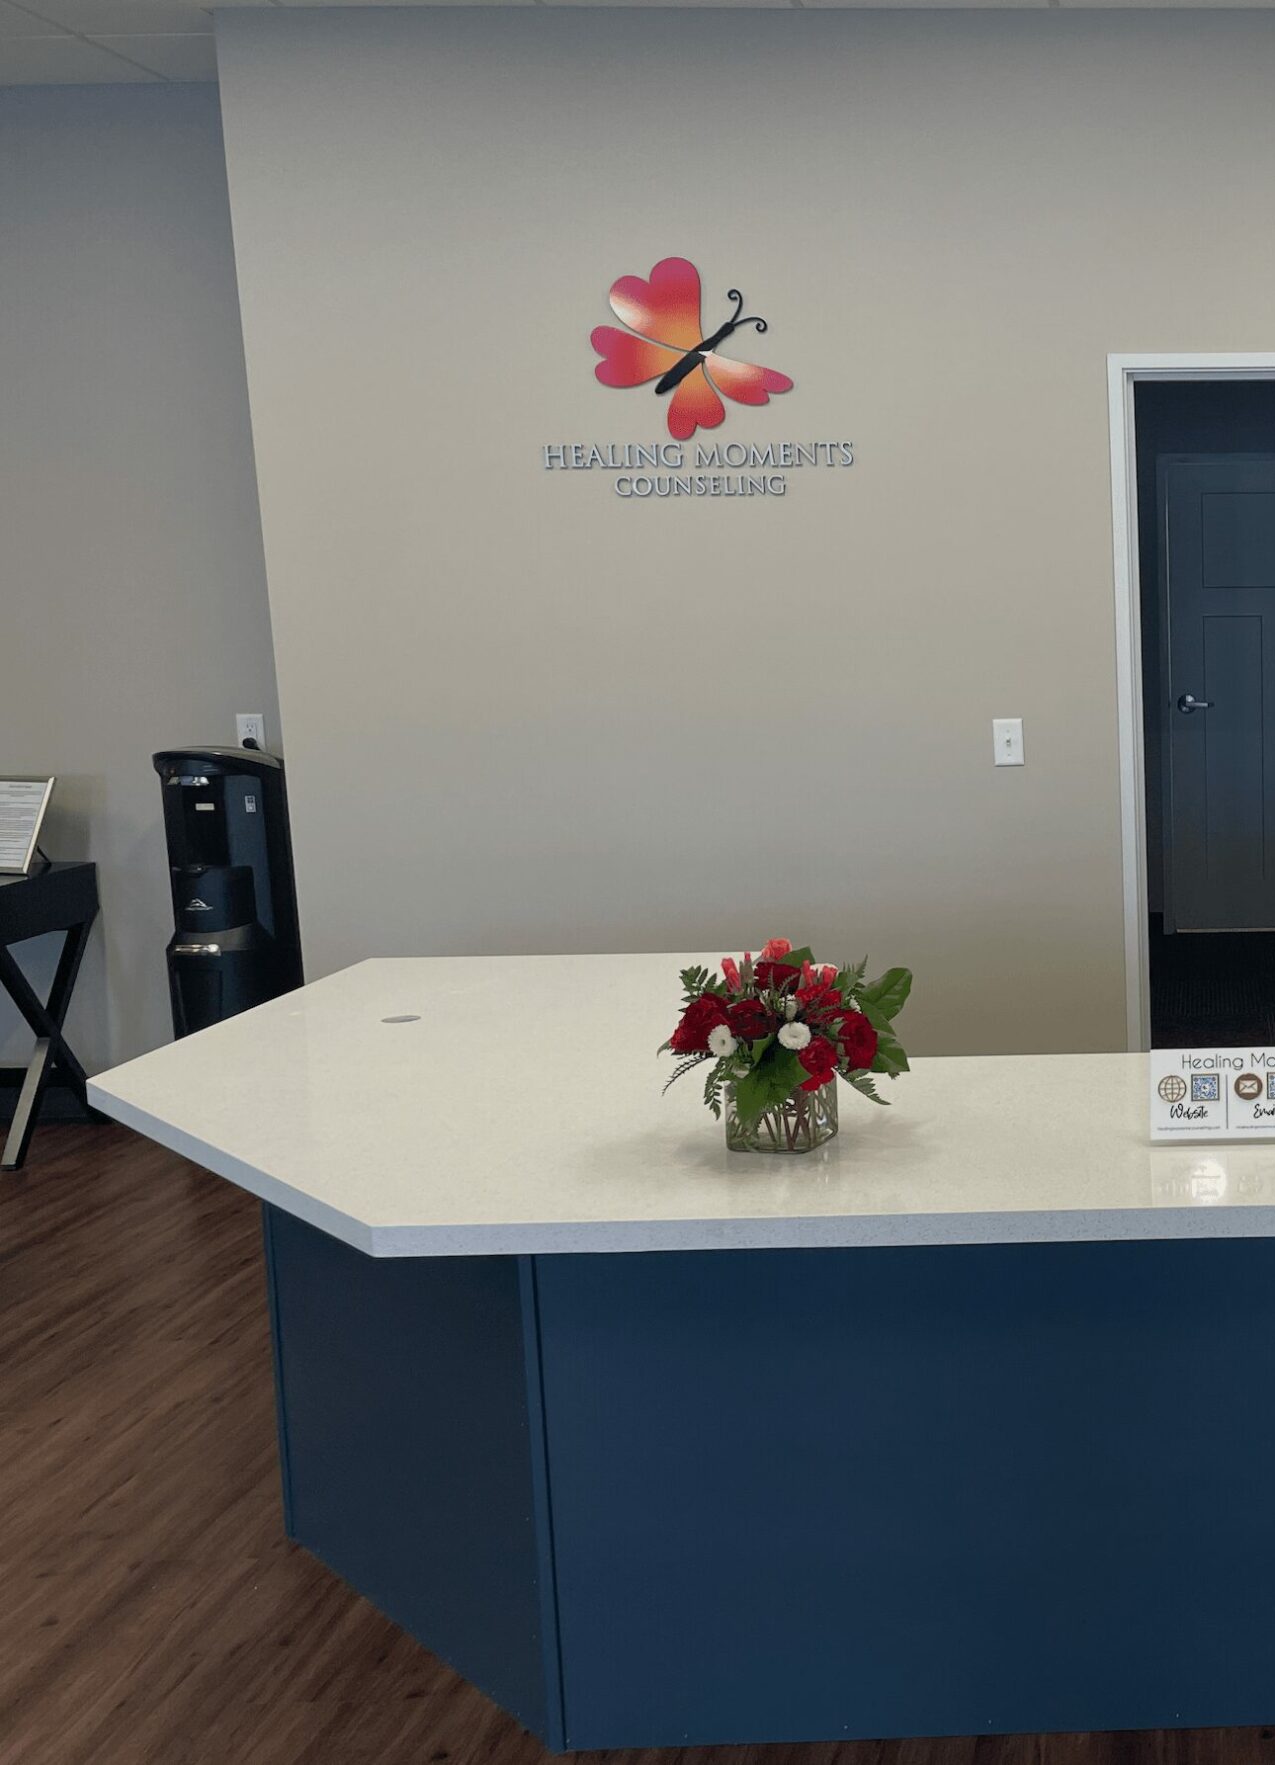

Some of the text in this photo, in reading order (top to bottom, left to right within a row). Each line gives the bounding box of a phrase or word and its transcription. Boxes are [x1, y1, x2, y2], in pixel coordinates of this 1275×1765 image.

[543, 440, 855, 469] HEALING MOMENTS
[614, 473, 787, 497] COUNSELING
[1181, 1053, 1244, 1071] Healing
[1169, 1103, 1209, 1120] Website
